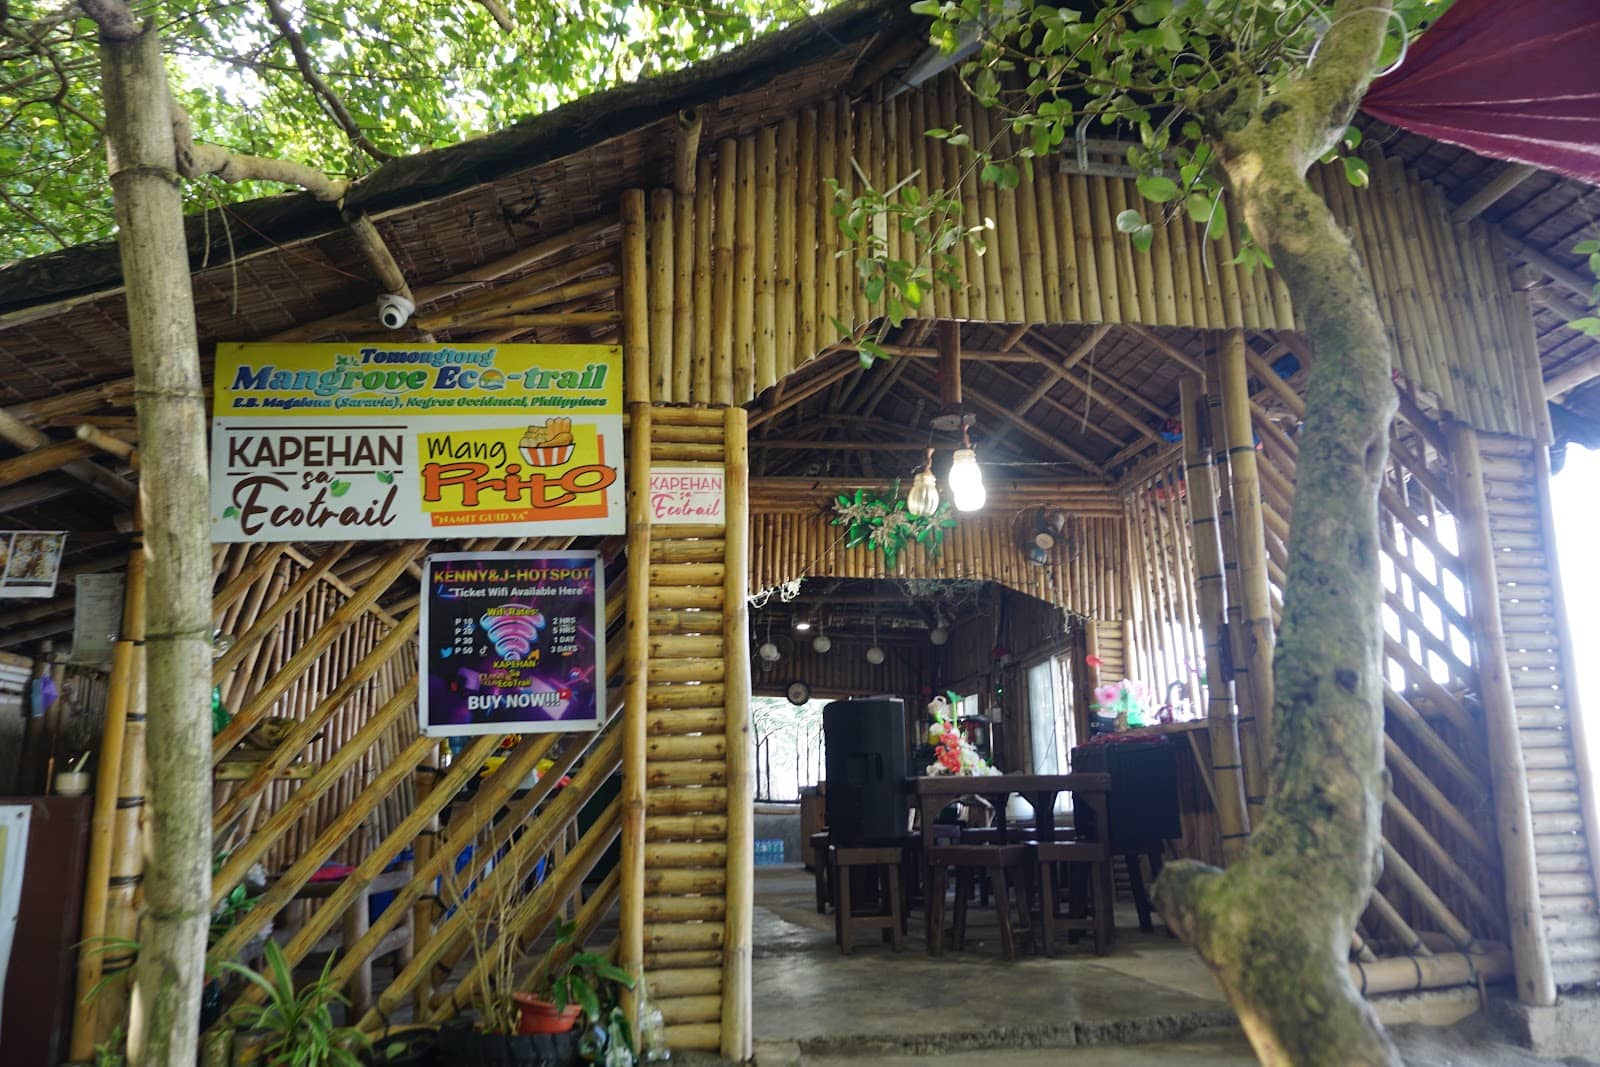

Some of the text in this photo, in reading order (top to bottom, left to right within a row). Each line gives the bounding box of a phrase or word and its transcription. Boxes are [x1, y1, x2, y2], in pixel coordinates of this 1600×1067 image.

[360, 348, 496, 367] Tomongtong
[232, 364, 608, 396] Mangrove Eco-trail
[406, 396, 455, 409] Negros
[457, 396, 527, 408] Occidental,
[530, 396, 608, 408] Philippines
[228, 435, 403, 467] KAPEHAN
[427, 435, 507, 469] Mang
[302, 471, 334, 490] sa
[650, 476, 722, 491] KAPEHAN
[232, 475, 398, 536] Ecotrail
[651, 493, 720, 519] Ecotrail
[488, 586, 509, 597] Wifi
[510, 585, 557, 596] Available
[486, 607, 505, 616] Wifi
[493, 660, 537, 668] KAPEHAN
[468, 692, 561, 710] BUY NOW!!!
